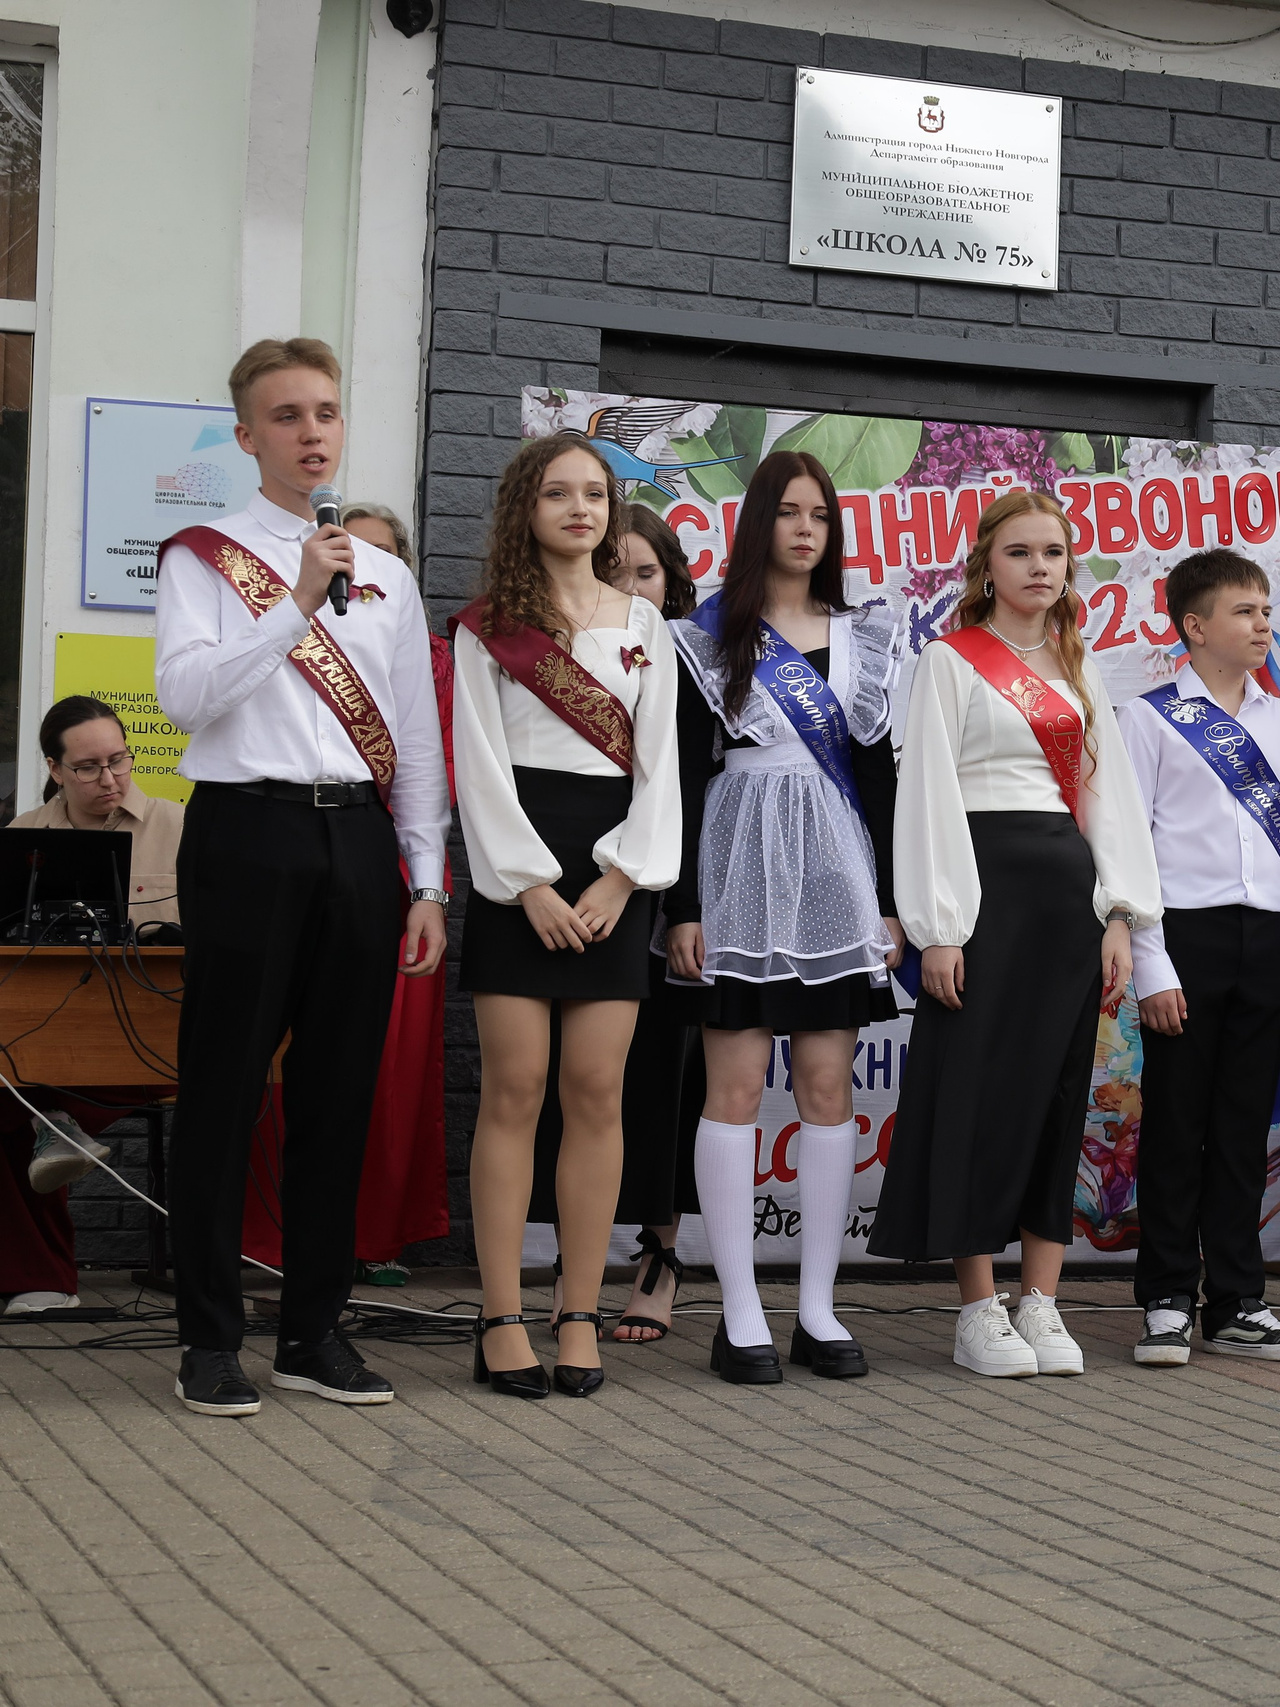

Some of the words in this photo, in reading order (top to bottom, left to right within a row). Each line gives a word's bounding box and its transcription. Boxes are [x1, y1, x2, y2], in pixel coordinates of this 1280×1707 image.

[823, 130, 906, 147] Администрация
[908, 141, 943, 153] города
[945, 143, 993, 158] Нижнего
[995, 149, 1049, 165] Новгорода
[870, 149, 938, 164] Департамент
[940, 156, 1004, 172] образования
[821, 170, 945, 193] МУНИЦИПАЛЬНОЕ
[947, 184, 1034, 203] БЮДЖЕТНОЕ
[845, 187, 1011, 214] ОБЩЕОБРАЗОВАТЕЛЬНОЕ
[882, 205, 974, 224] УЧРЕЖДЕНИЕ
[816, 228, 946, 260] «ШКОЛА
[953, 240, 988, 264] №
[995, 245, 1034, 268] 75»
[154, 498, 207, 507] ОБРАЗОВАТЕЛЬНАЯ
[208, 500, 226, 508] СРЕДА
[106, 703, 164, 715] БРАЗОВ
[123, 721, 188, 736] «ШКОЛ
[351, 710, 398, 785] 2025
